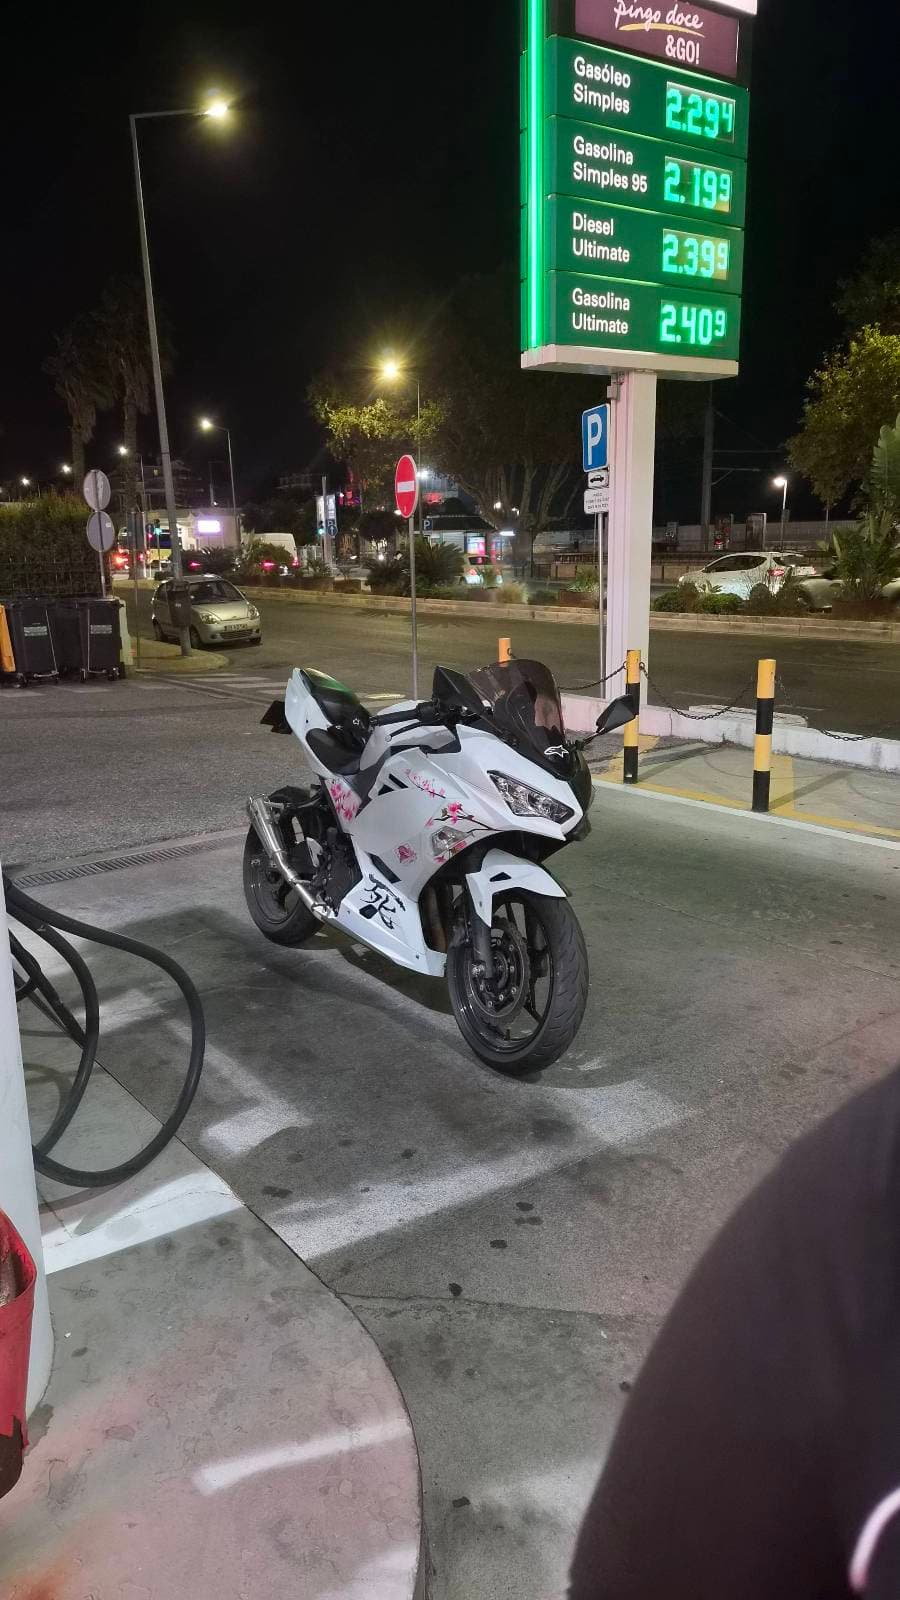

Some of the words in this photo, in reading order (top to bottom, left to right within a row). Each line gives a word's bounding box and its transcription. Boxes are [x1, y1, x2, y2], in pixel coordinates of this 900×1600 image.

[666, 4, 704, 29] doce
[665, 34, 700, 65] &GO!
[573, 56, 631, 89] Gasóleo
[573, 82, 630, 114] Simples
[573, 136, 634, 166] Gasolina
[573, 162, 629, 190] Simples
[631, 174, 648, 193] 95
[572, 212, 614, 236] Diesel
[572, 237, 630, 263] Ultimate
[572, 287, 630, 311] Gasolina
[572, 312, 629, 335] Ultimate
[587, 413, 602, 466] P
